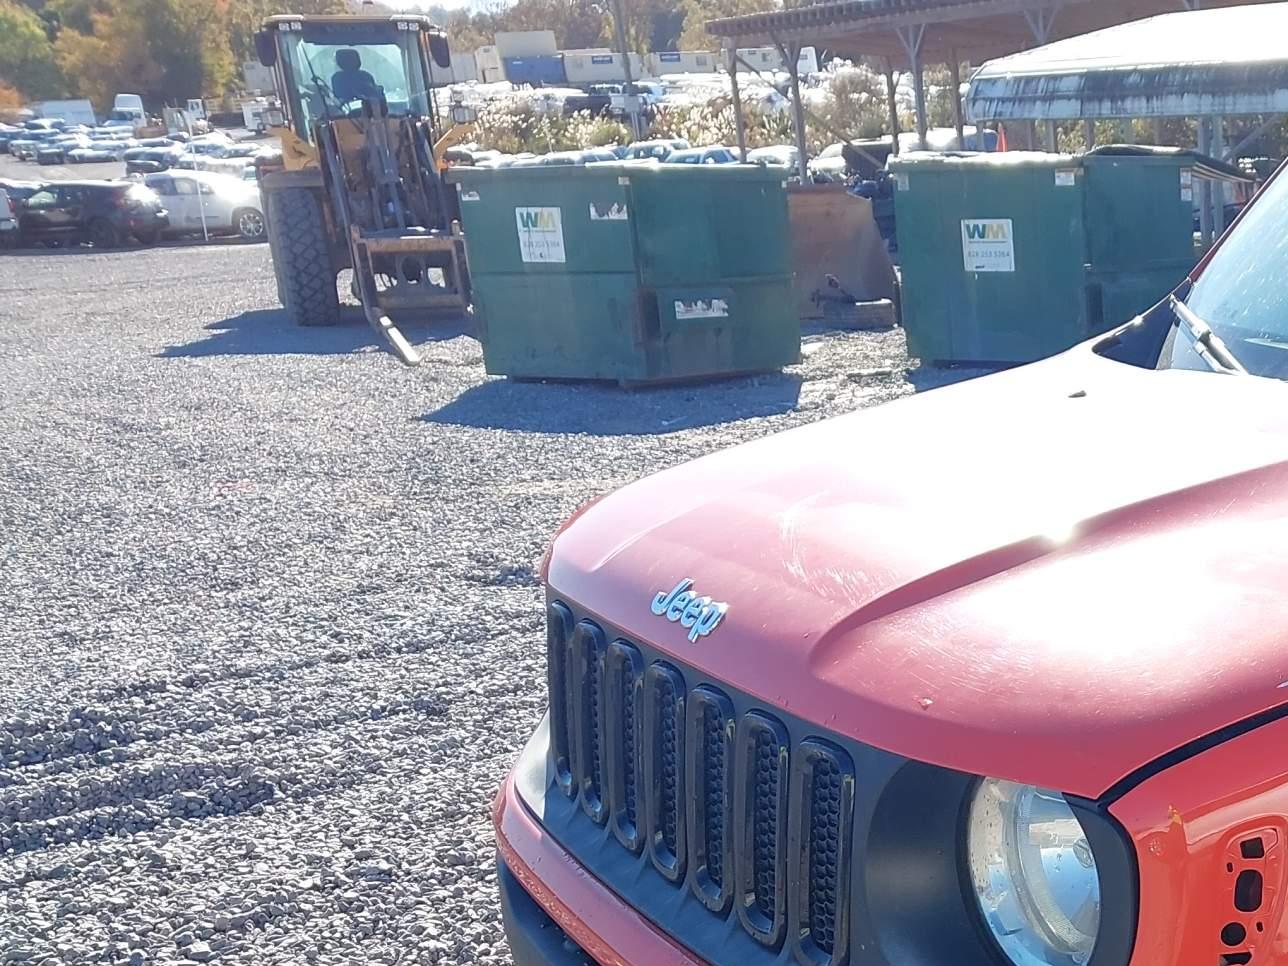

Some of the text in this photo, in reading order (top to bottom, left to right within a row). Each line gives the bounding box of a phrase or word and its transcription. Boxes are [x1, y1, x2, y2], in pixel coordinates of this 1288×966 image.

[520, 212, 556, 228] WM
[965, 223, 1008, 240] WM
[650, 577, 729, 643] Jeep
